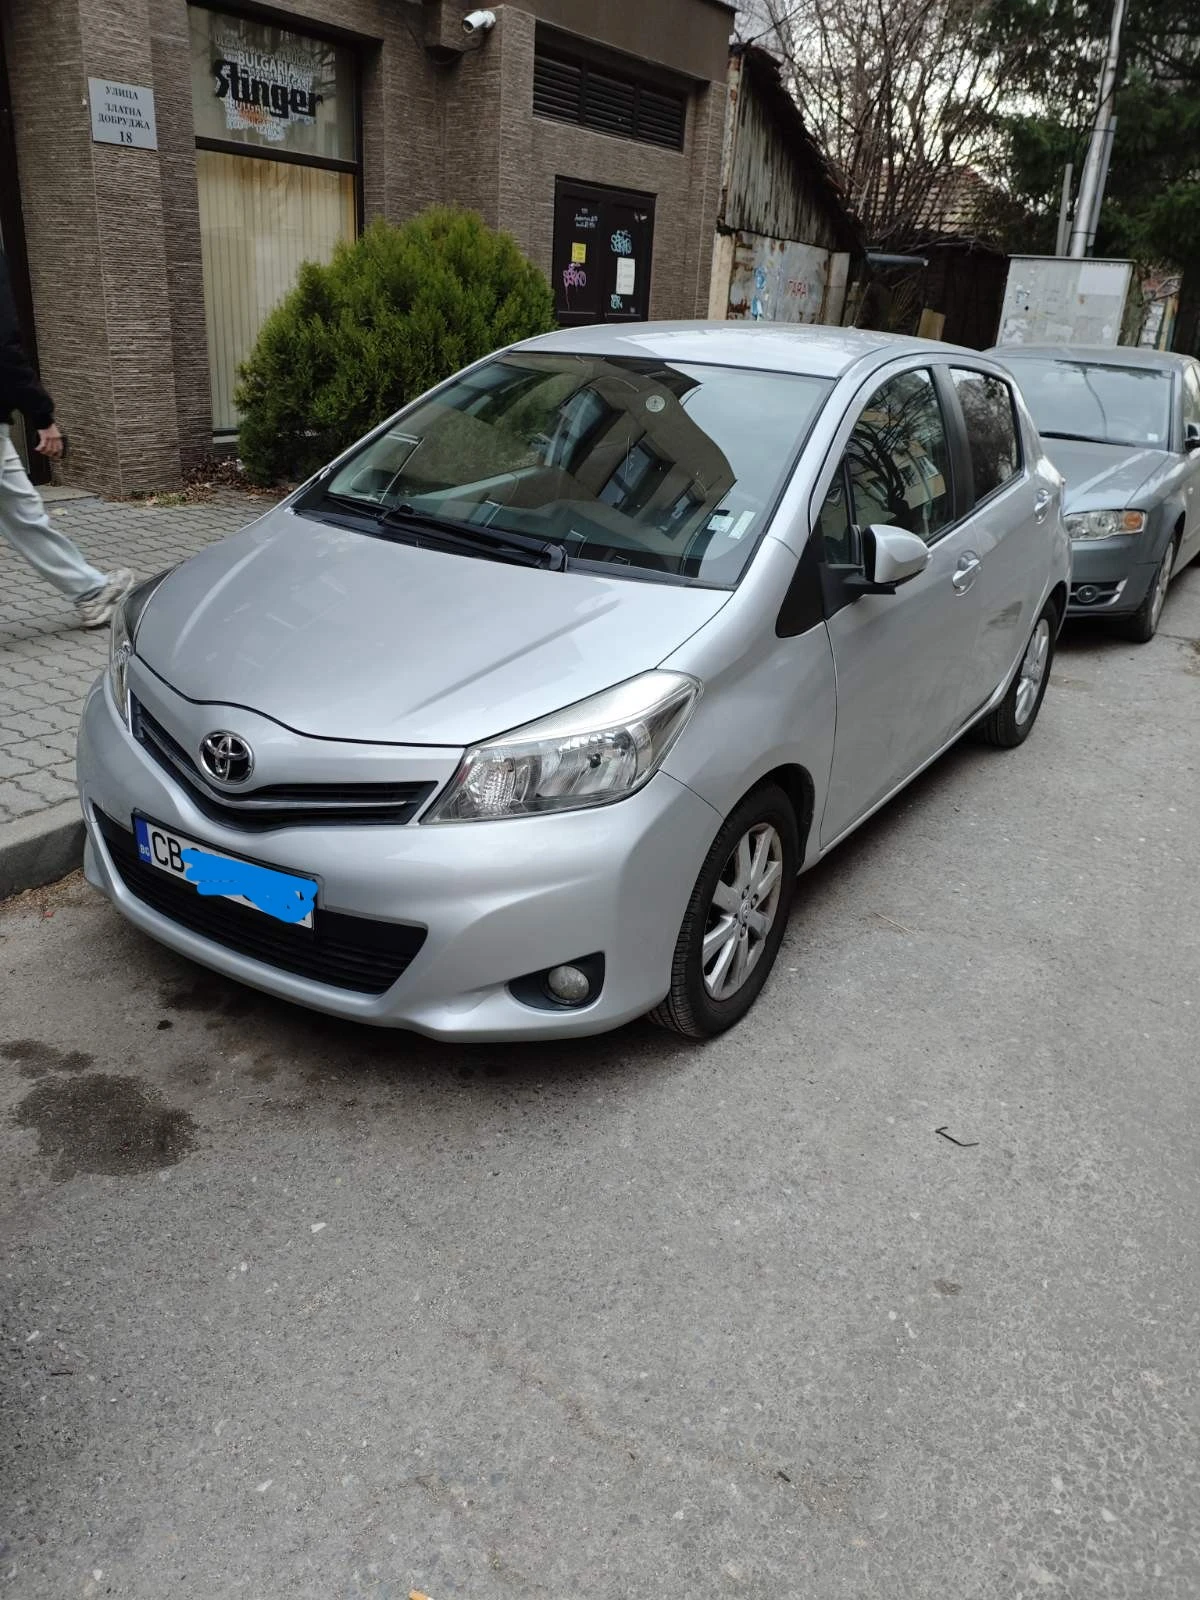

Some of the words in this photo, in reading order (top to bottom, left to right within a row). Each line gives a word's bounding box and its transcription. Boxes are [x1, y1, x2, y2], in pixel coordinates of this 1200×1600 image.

[238, 51, 296, 77] BULGARIA
[105, 86, 138, 100] УЛИЦА
[214, 59, 324, 118] Stinger
[98, 113, 150, 130] ДОБРУДЖА
[120, 131, 133, 143] 18
